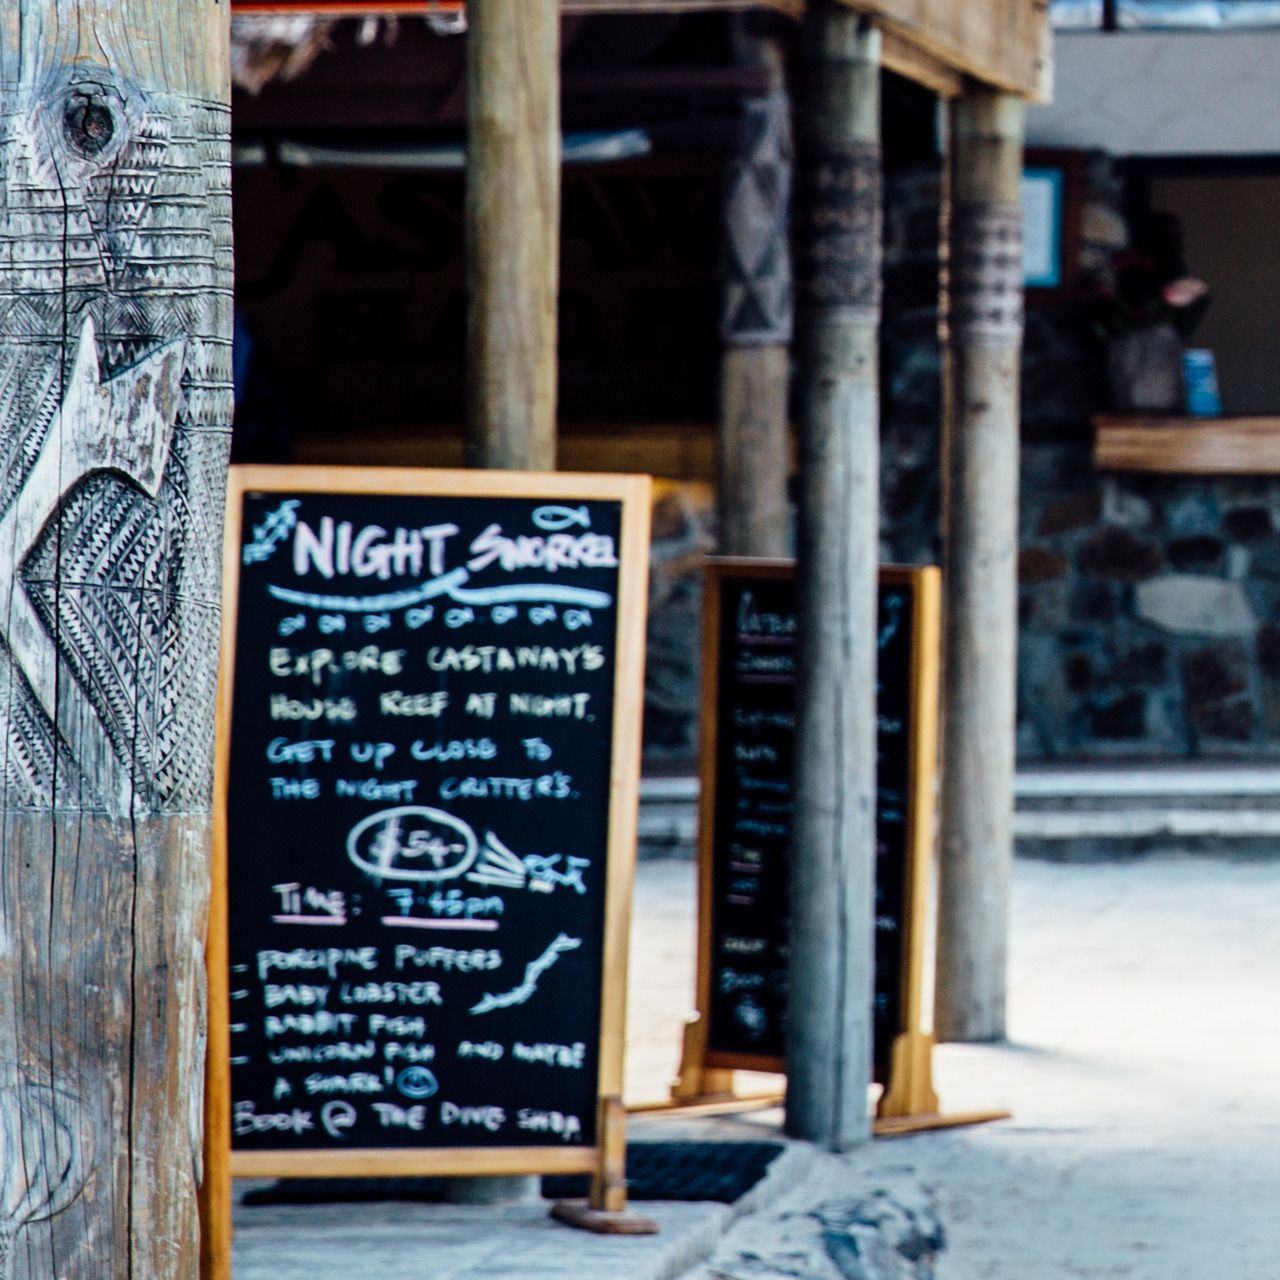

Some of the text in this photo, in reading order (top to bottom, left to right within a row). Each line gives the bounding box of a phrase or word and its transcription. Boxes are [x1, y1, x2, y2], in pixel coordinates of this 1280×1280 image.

[293, 516, 459, 580] NIGHT
[380, 690, 449, 718] REEF
[465, 692, 498, 720] AT
[267, 737, 553, 770] GET UP CLOSE TO
[269, 777, 320, 800] THE
[336, 777, 418, 803] NIGHT
[264, 980, 443, 1011] BABY LOBSTER
[368, 1013, 427, 1039] FISH
[384, 1041, 435, 1063] FISH
[457, 1040, 504, 1061] AND
[321, 1099, 357, 1138] @
[370, 1102, 427, 1131] THE
